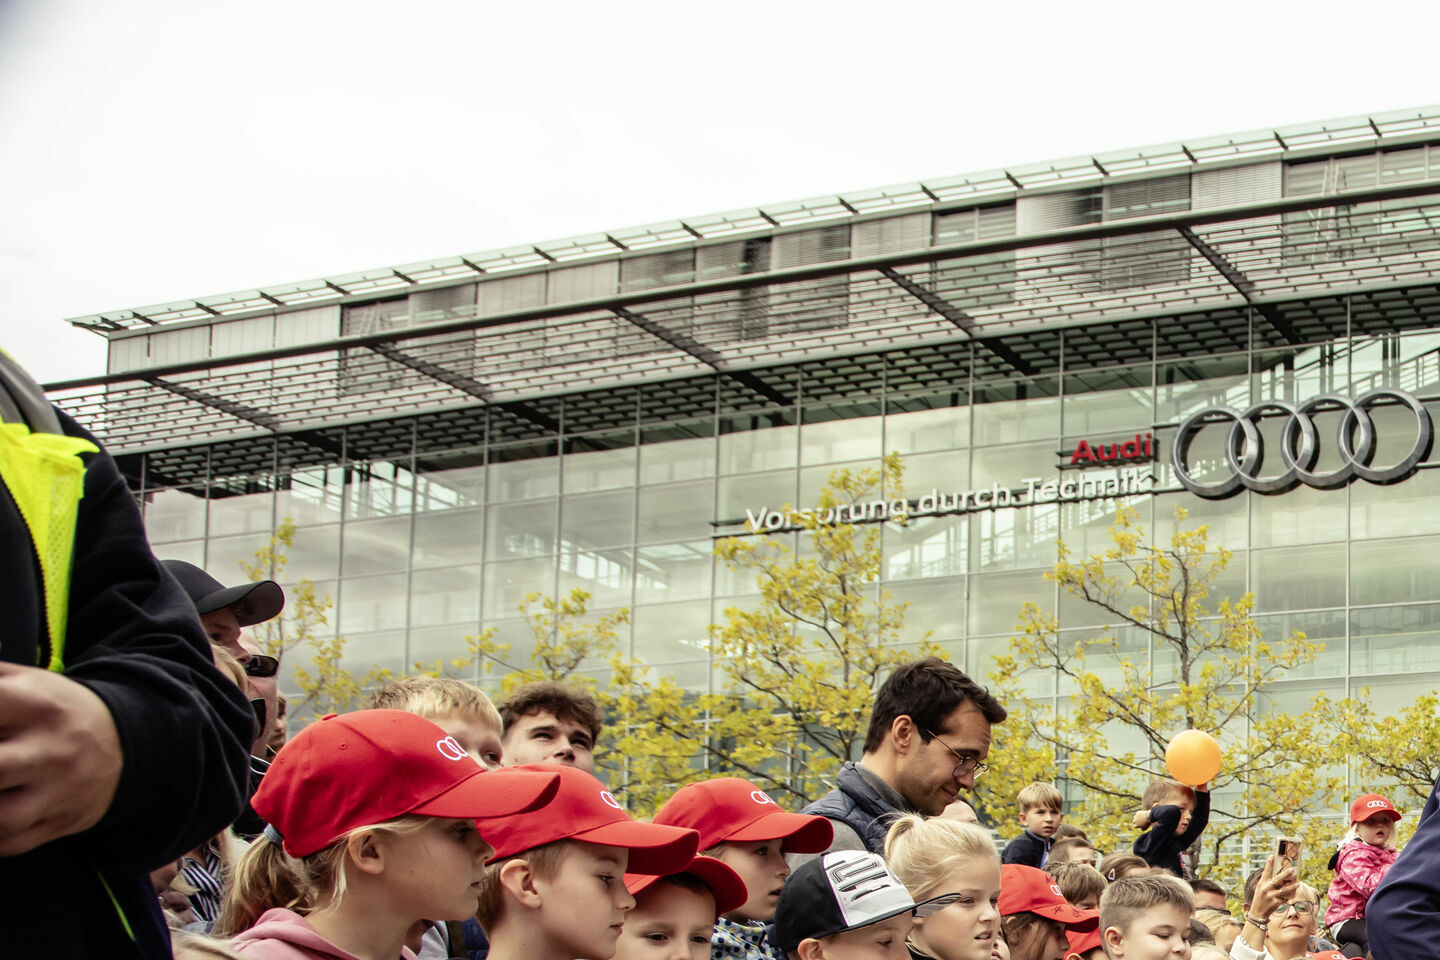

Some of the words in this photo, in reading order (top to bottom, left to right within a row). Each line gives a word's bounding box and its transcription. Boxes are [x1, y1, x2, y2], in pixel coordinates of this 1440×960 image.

[1070, 433, 1152, 464] Audi
[918, 481, 1012, 513] durch
[1021, 469, 1148, 501] Technik
